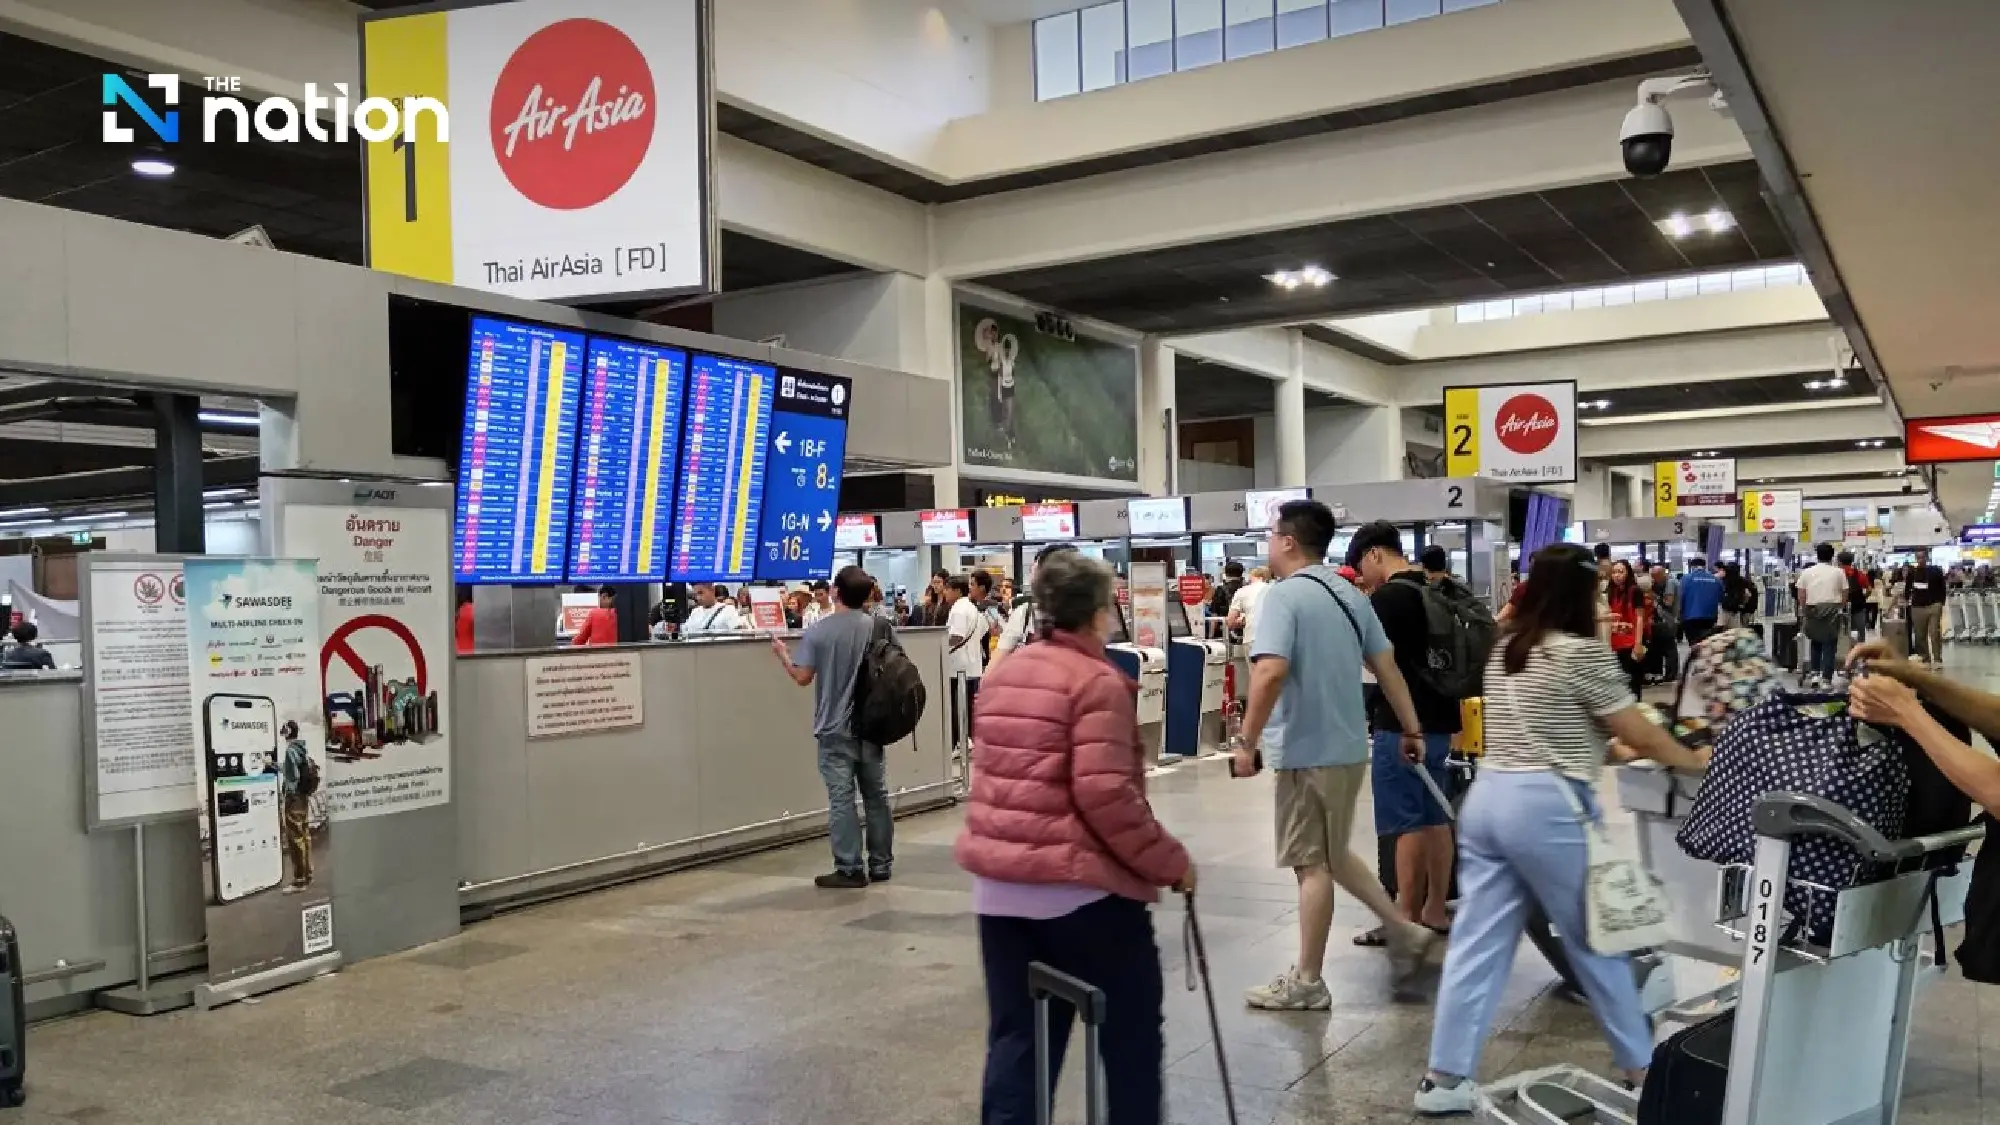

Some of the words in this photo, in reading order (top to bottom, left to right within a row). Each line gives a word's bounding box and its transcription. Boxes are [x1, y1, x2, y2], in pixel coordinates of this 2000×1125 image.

[482, 259, 524, 284] Thai
[530, 252, 603, 281] AirAsia
[799, 439, 827, 458] 1B-F
[1453, 424, 1472, 457] 2
[816, 462, 828, 489] 8
[1447, 485, 1463, 508] 2
[1660, 482, 1672, 503] 3
[346, 513, 401, 532] อันตราย
[781, 511, 810, 532] 1G-N
[1674, 521, 1684, 535] 3
[353, 535, 394, 549] Danger
[782, 535, 803, 561] 16
[235, 596, 292, 608] SAWASDEE
